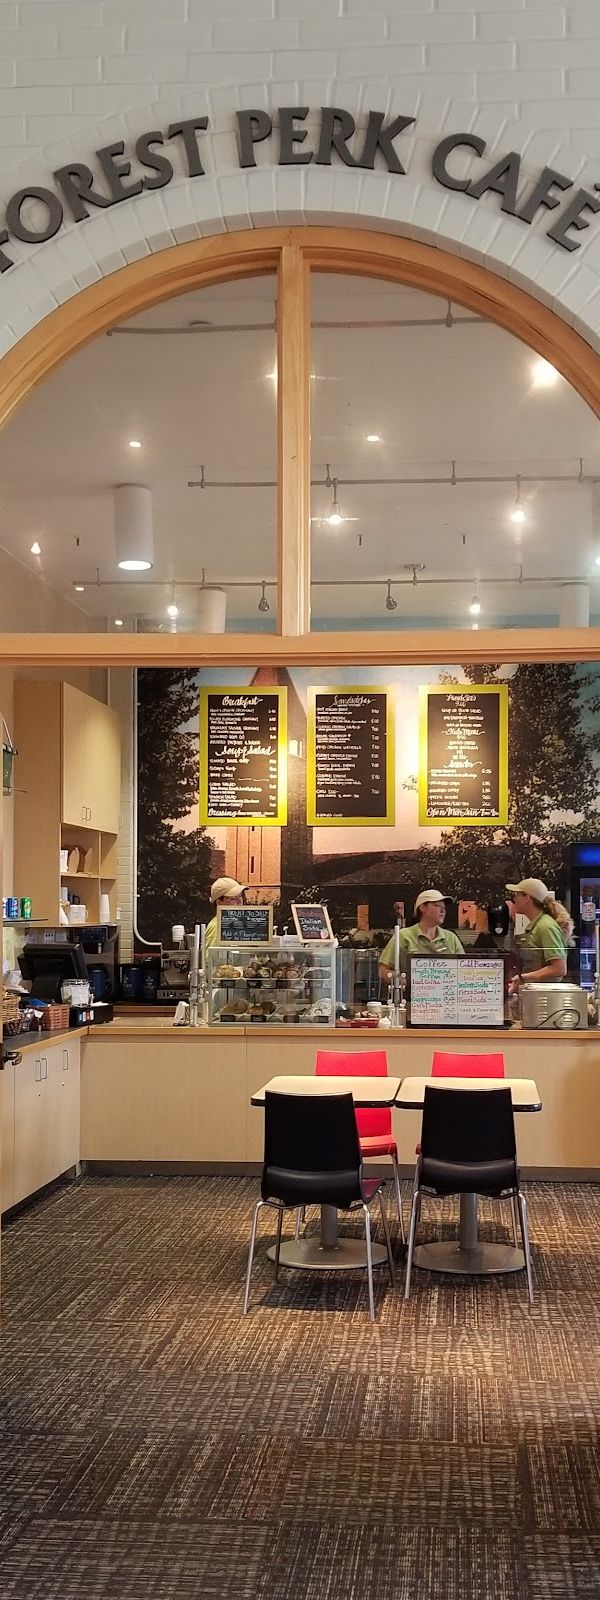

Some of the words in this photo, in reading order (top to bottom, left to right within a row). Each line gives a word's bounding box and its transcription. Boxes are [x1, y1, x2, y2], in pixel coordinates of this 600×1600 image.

[236, 107, 416, 176] PERK
[222, 696, 263, 708] Breakfast
[329, 695, 376, 707] Sandwiches
[215, 745, 242, 758] Soup
[248, 745, 276, 756] Salad
[415, 959, 448, 967] Coffee
[460, 960, 473, 968] Cold
[474, 961, 502, 969] Beverages
